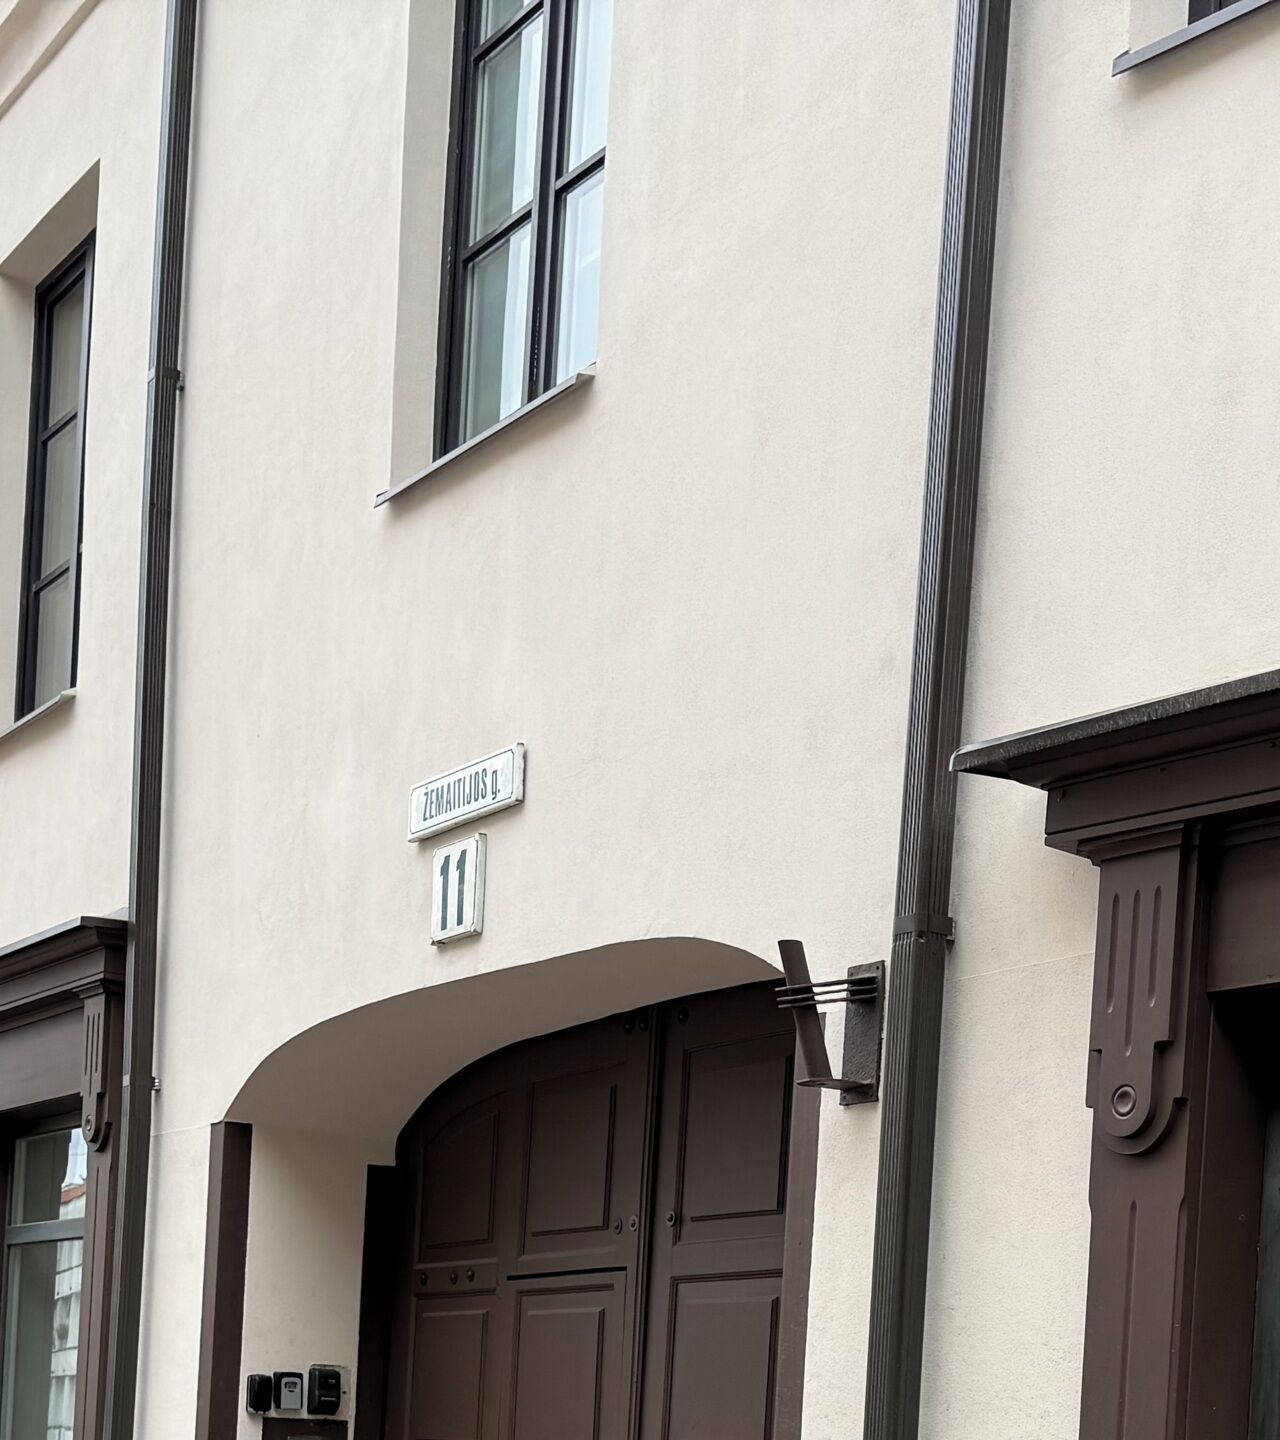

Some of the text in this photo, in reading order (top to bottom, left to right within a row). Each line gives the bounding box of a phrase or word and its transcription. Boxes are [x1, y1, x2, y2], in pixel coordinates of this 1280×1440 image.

[423, 768, 501, 822] ŽEMAITIJOS g.
[440, 848, 467, 932] 11
